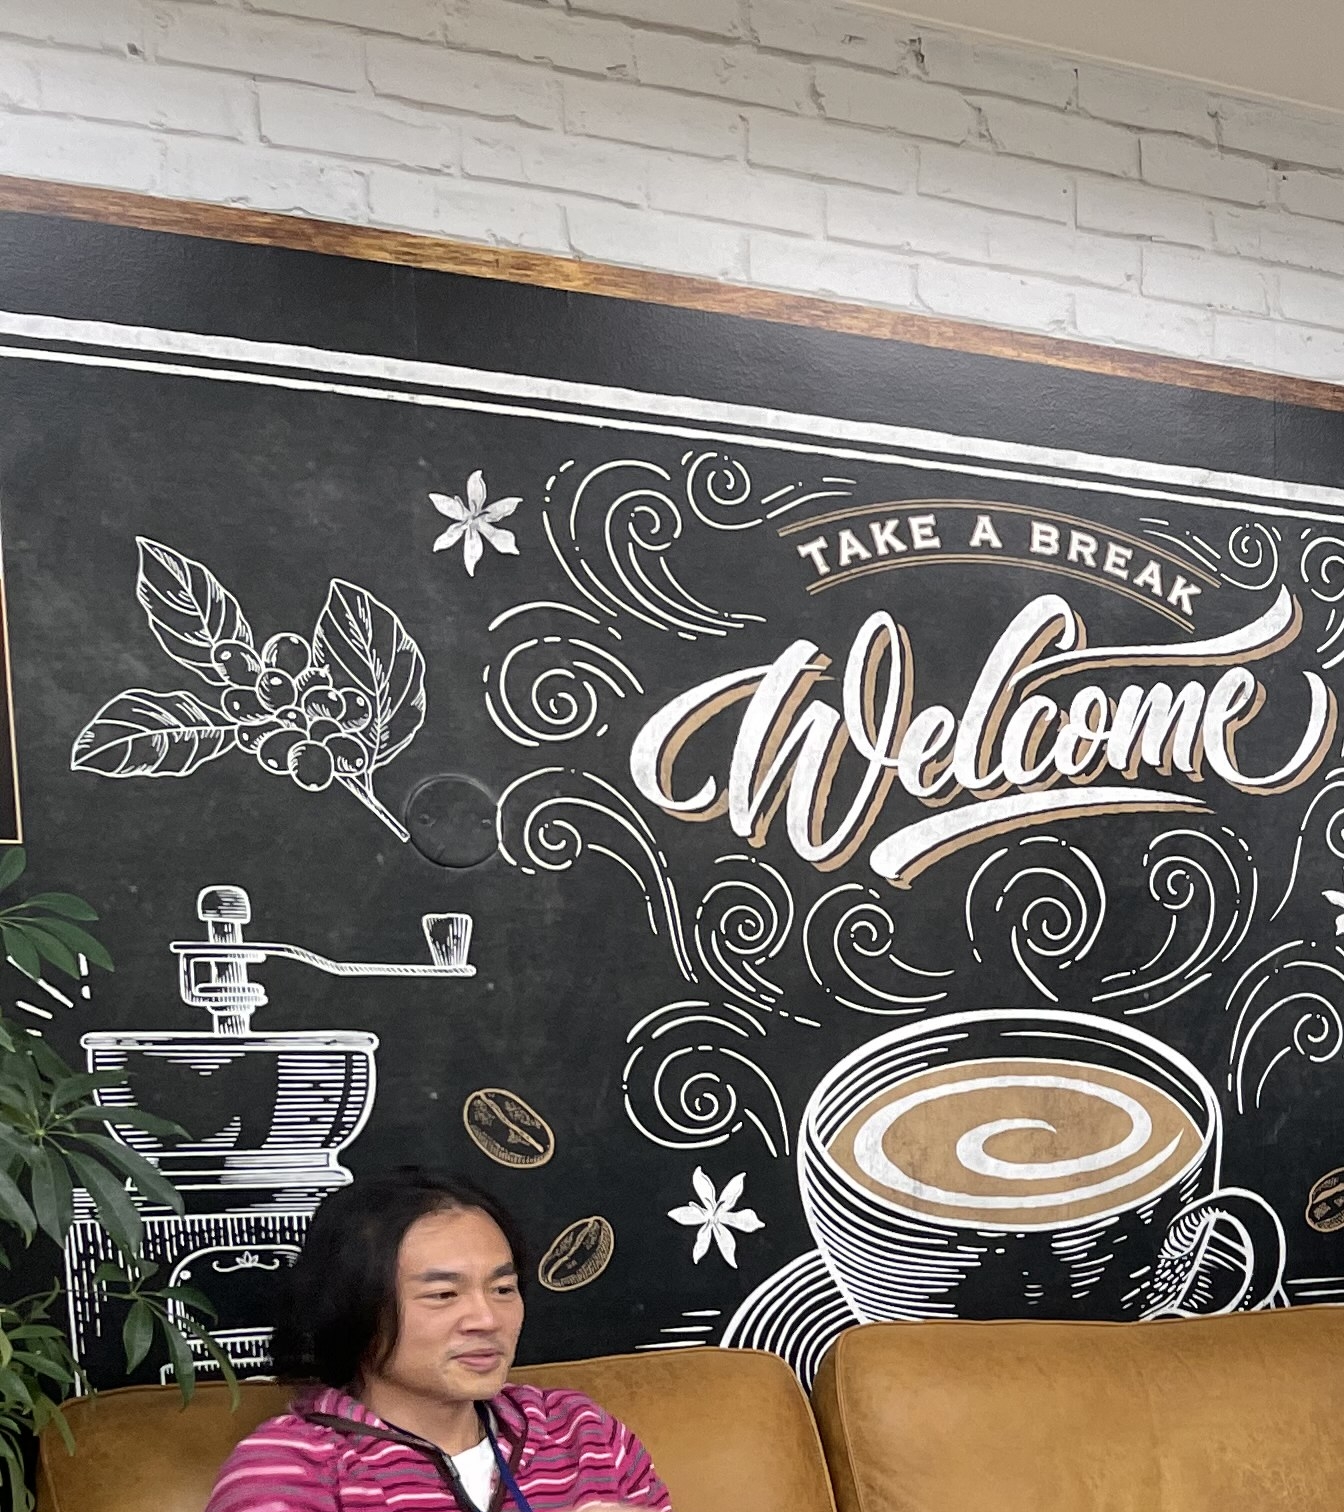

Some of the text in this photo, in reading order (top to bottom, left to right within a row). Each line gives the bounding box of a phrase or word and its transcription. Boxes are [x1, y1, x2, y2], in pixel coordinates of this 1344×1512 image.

[798, 514, 1203, 615] TAKE A BREAK
[630, 584, 1336, 884] Welcome
